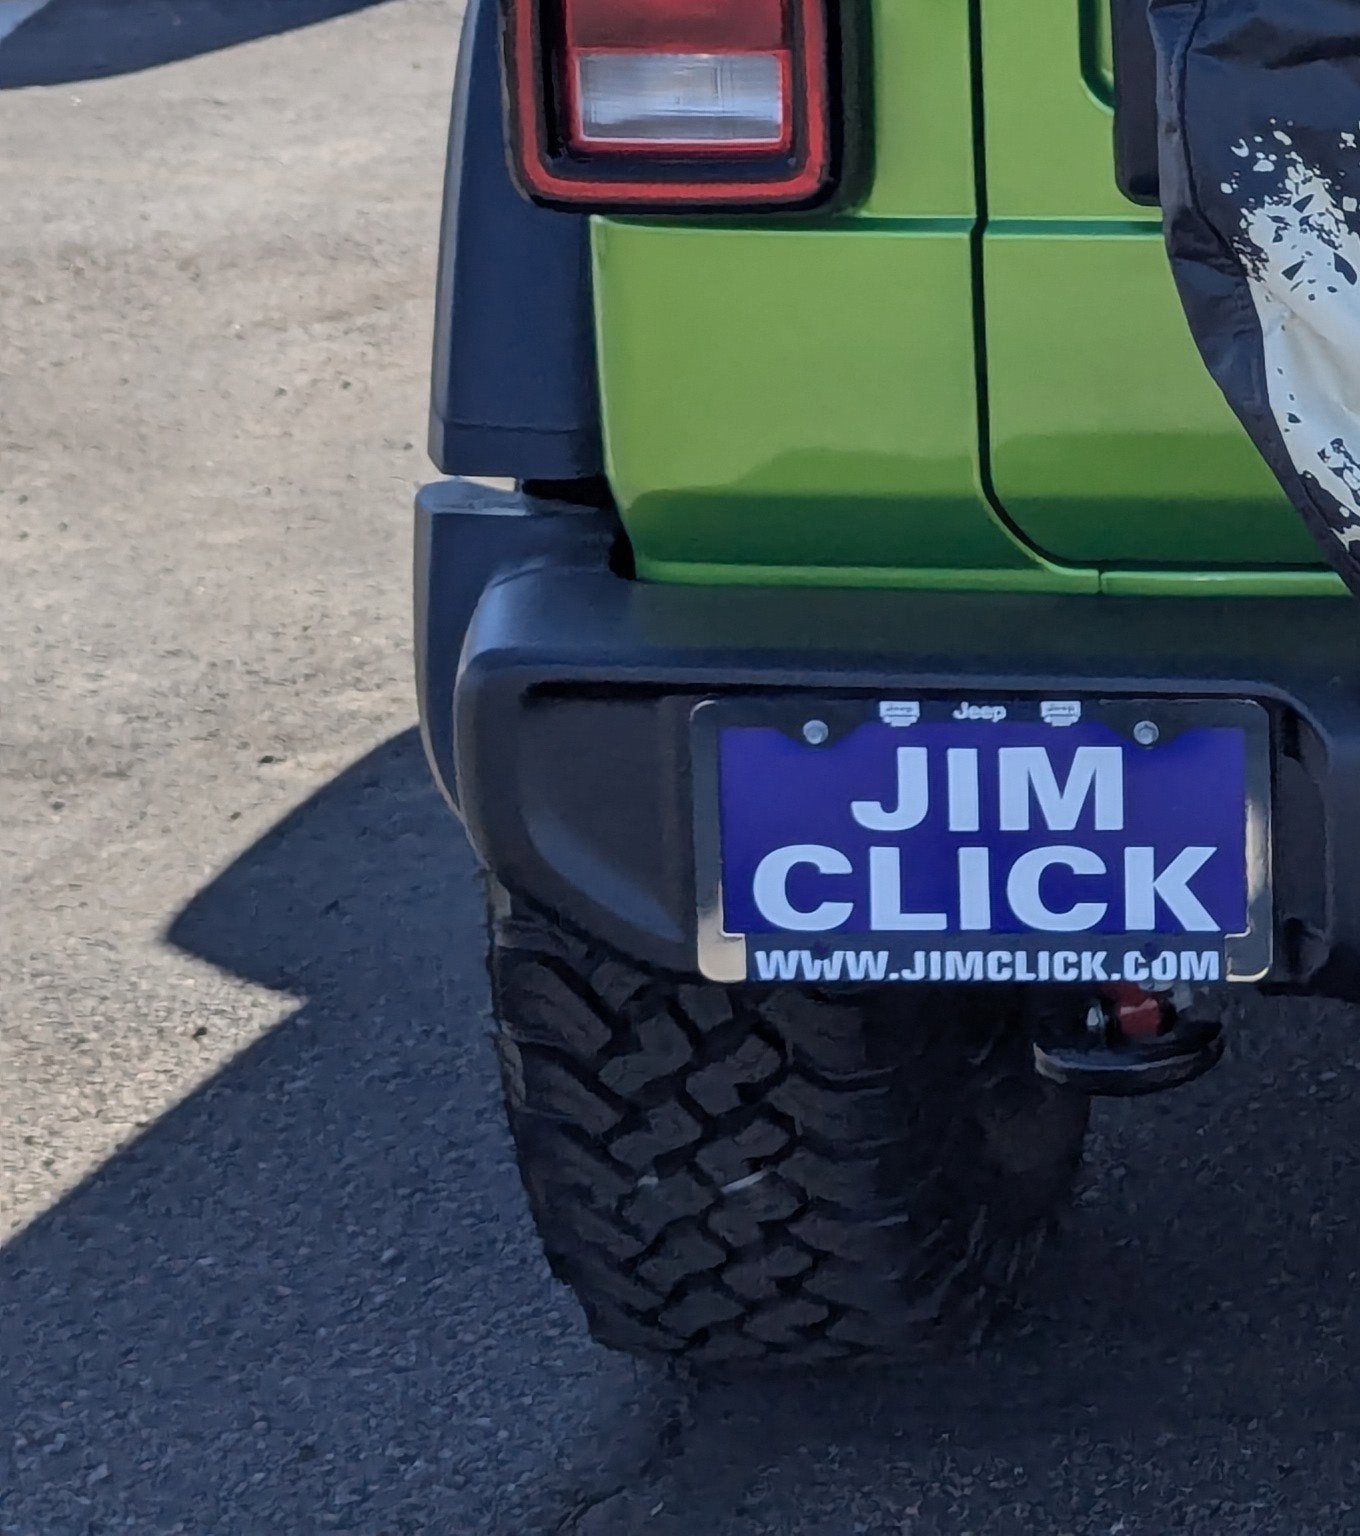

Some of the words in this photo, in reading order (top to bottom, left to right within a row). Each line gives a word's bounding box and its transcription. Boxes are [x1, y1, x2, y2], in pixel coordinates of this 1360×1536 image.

[952, 701, 1007, 722] Jeep
[850, 745, 1124, 832] JIM
[752, 843, 1220, 931] CLICK
[754, 949, 1220, 982] WWW.JIMCLICK.COM
